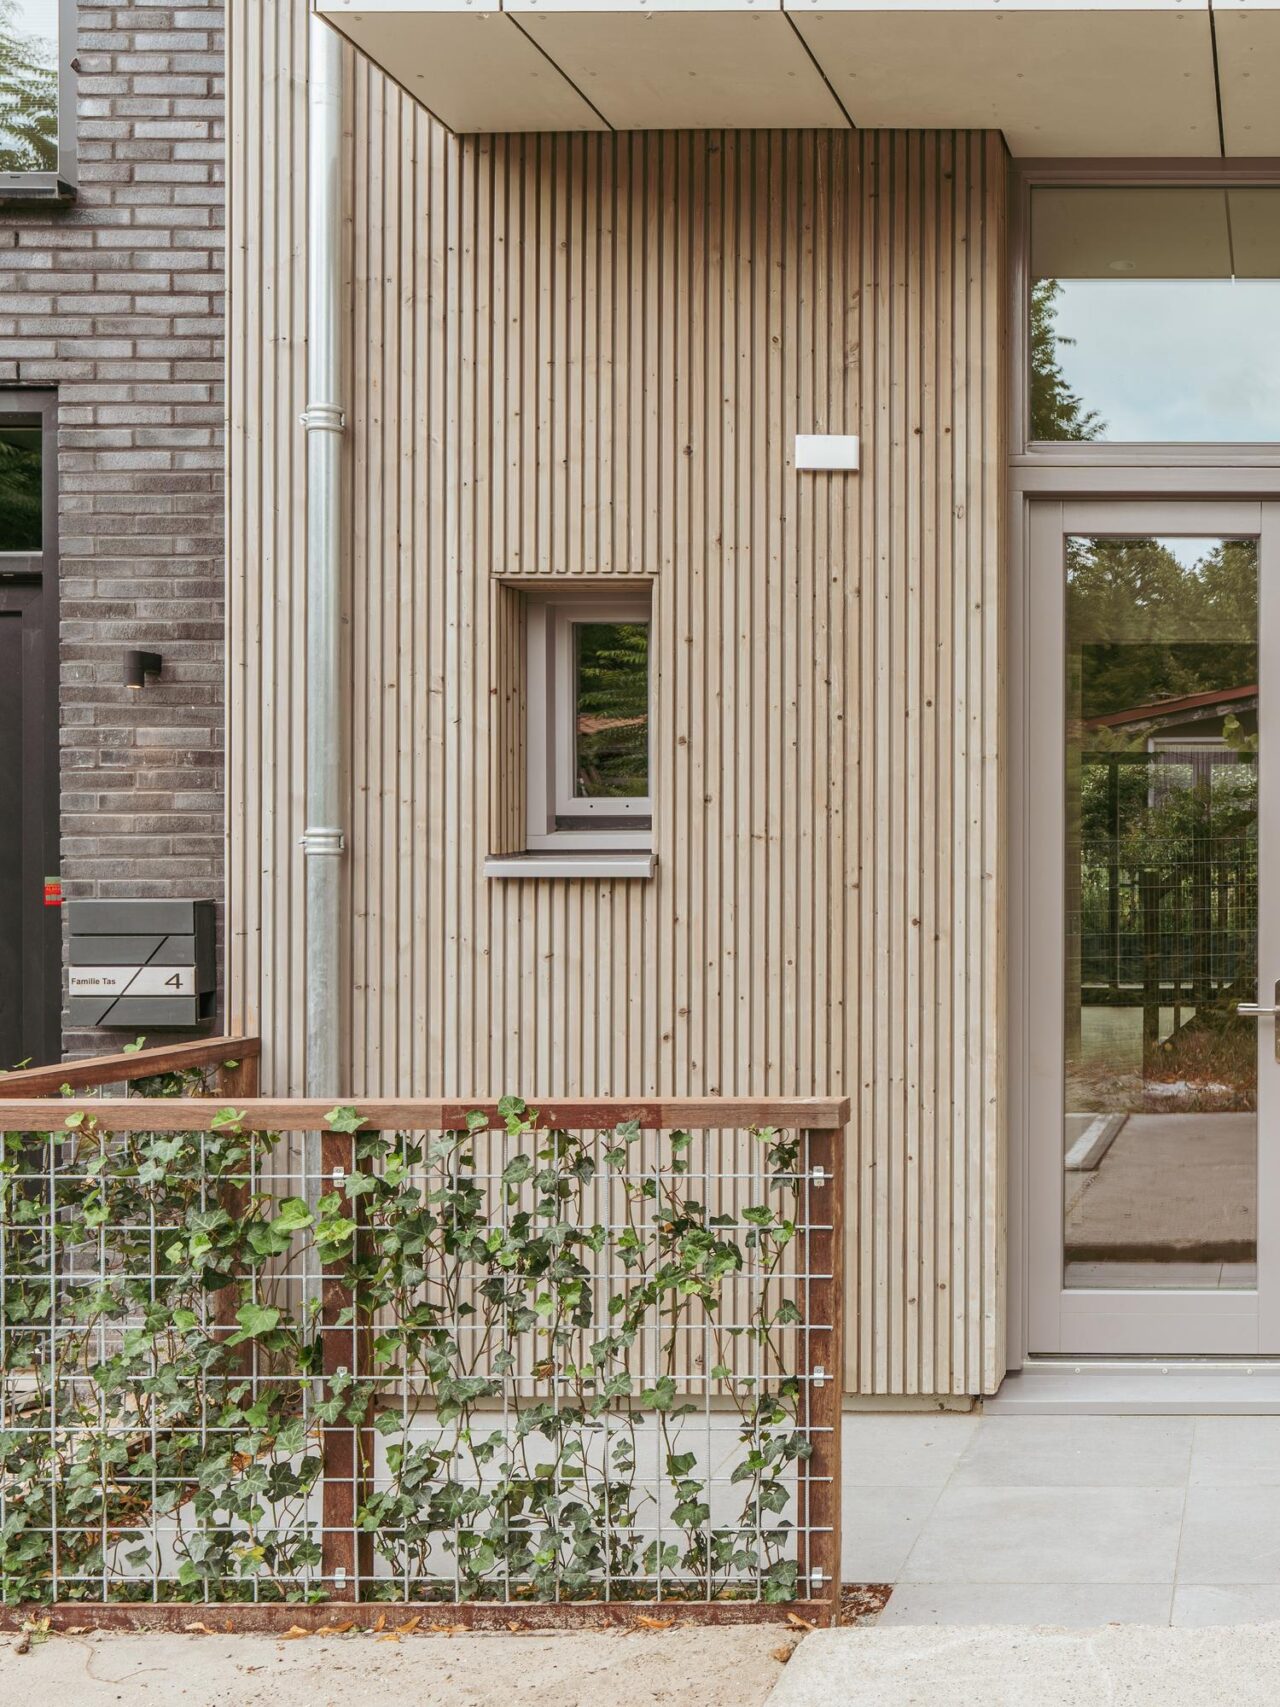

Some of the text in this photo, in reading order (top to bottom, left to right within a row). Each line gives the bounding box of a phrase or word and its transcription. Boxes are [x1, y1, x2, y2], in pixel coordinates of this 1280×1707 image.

[71, 977, 116, 985] Familie Tas
[164, 973, 183, 989] 4
